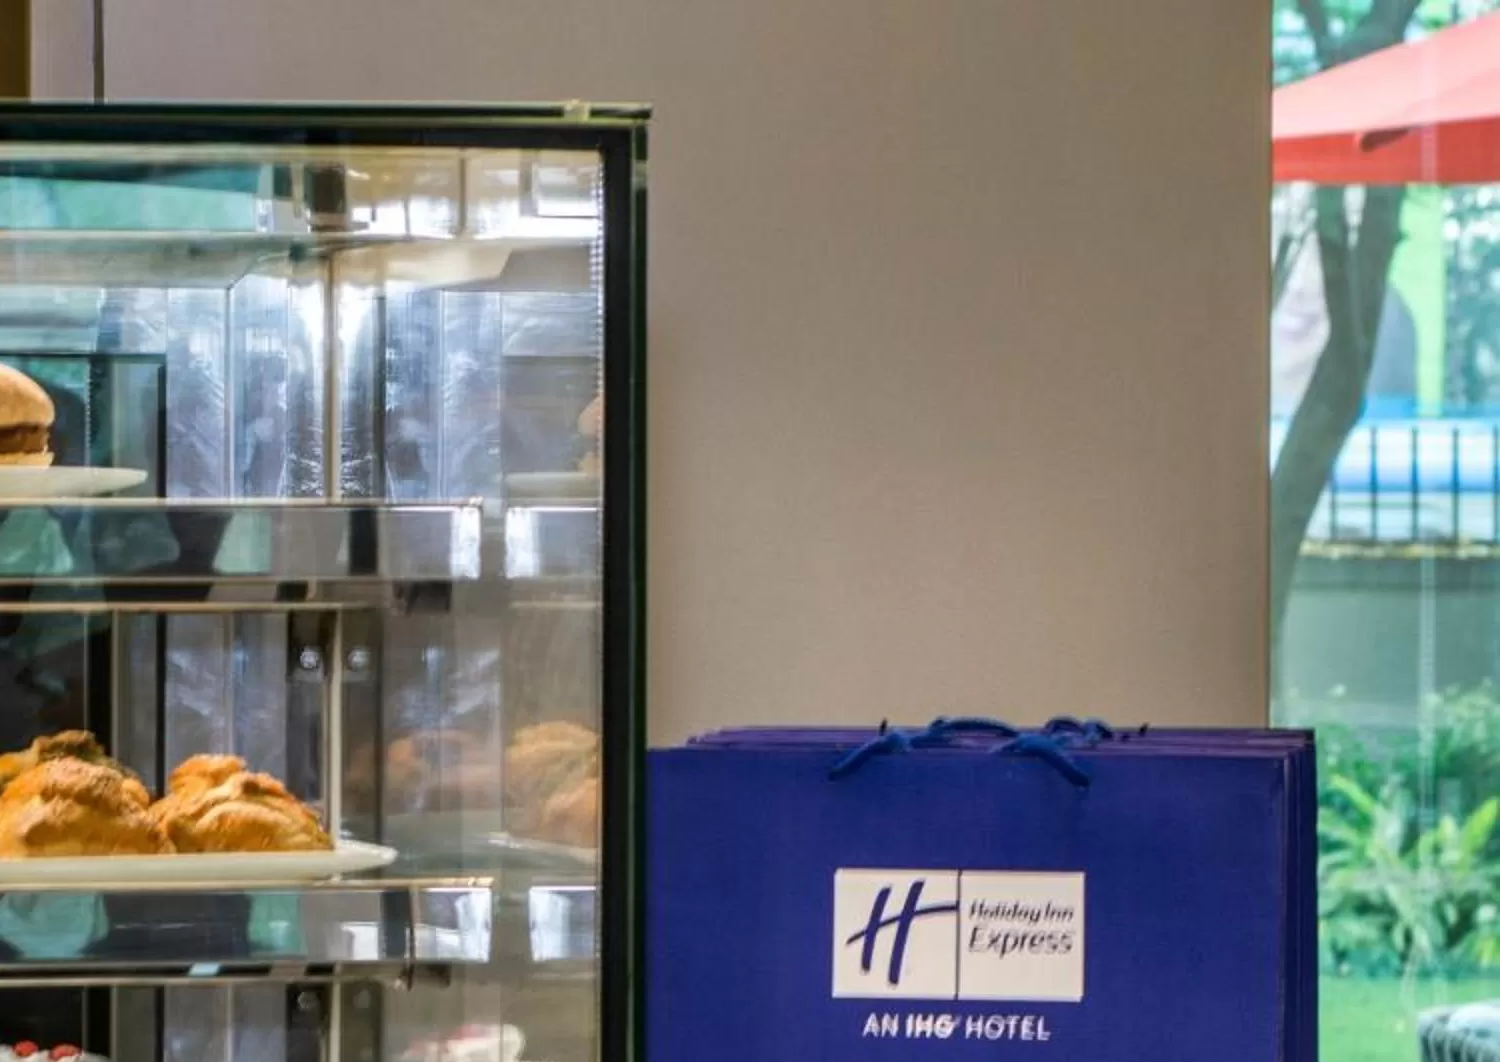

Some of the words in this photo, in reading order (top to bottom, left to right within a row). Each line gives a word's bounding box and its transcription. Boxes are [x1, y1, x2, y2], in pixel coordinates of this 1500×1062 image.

[969, 898, 1041, 924] Holiday
[1044, 901, 1075, 920] Inn
[968, 925, 1076, 960] Express
[862, 1012, 899, 1037] AN
[964, 1014, 1052, 1041] HOTEL
